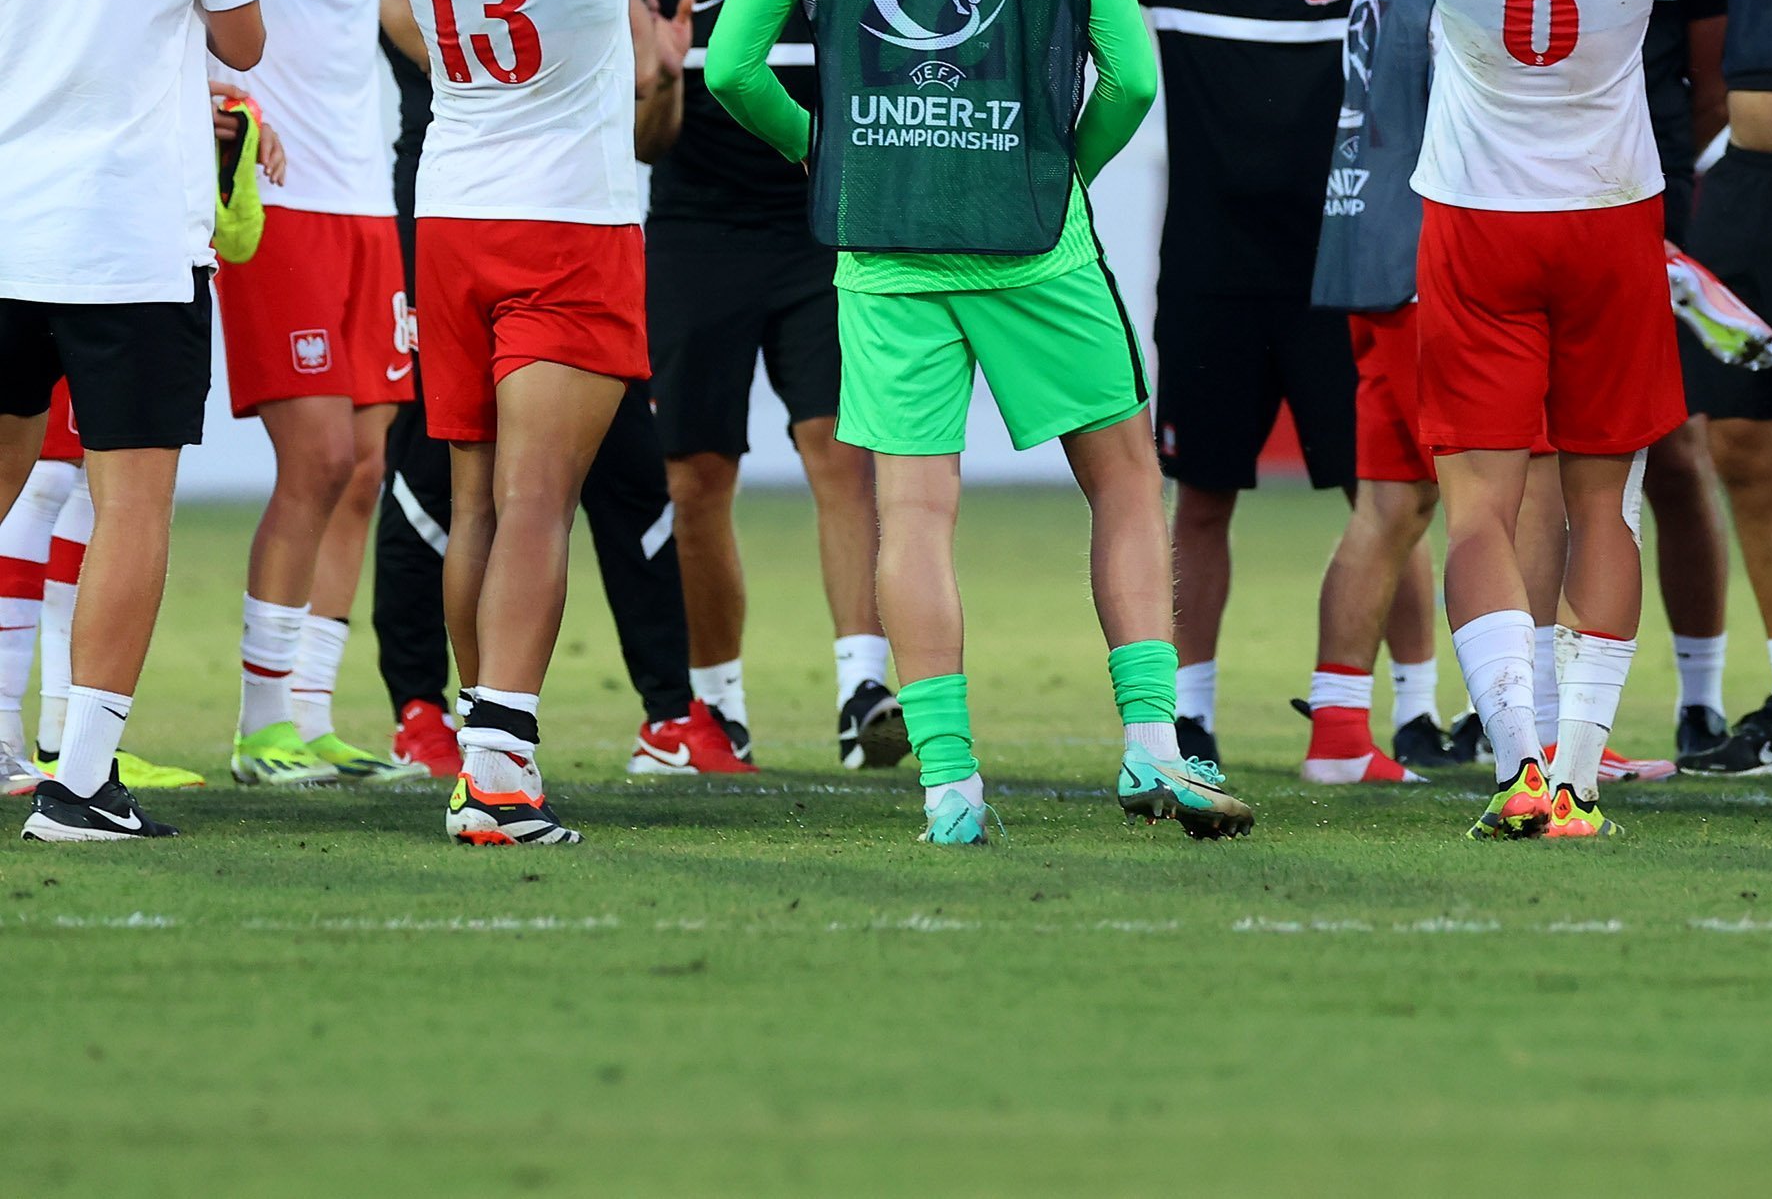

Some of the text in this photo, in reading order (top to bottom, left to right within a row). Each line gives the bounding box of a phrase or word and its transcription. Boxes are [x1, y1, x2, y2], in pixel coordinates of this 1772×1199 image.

[912, 66, 960, 87] UEFA
[851, 96, 1021, 130] UNDER-17
[851, 128, 1019, 152] CHAMPIONSHIP
